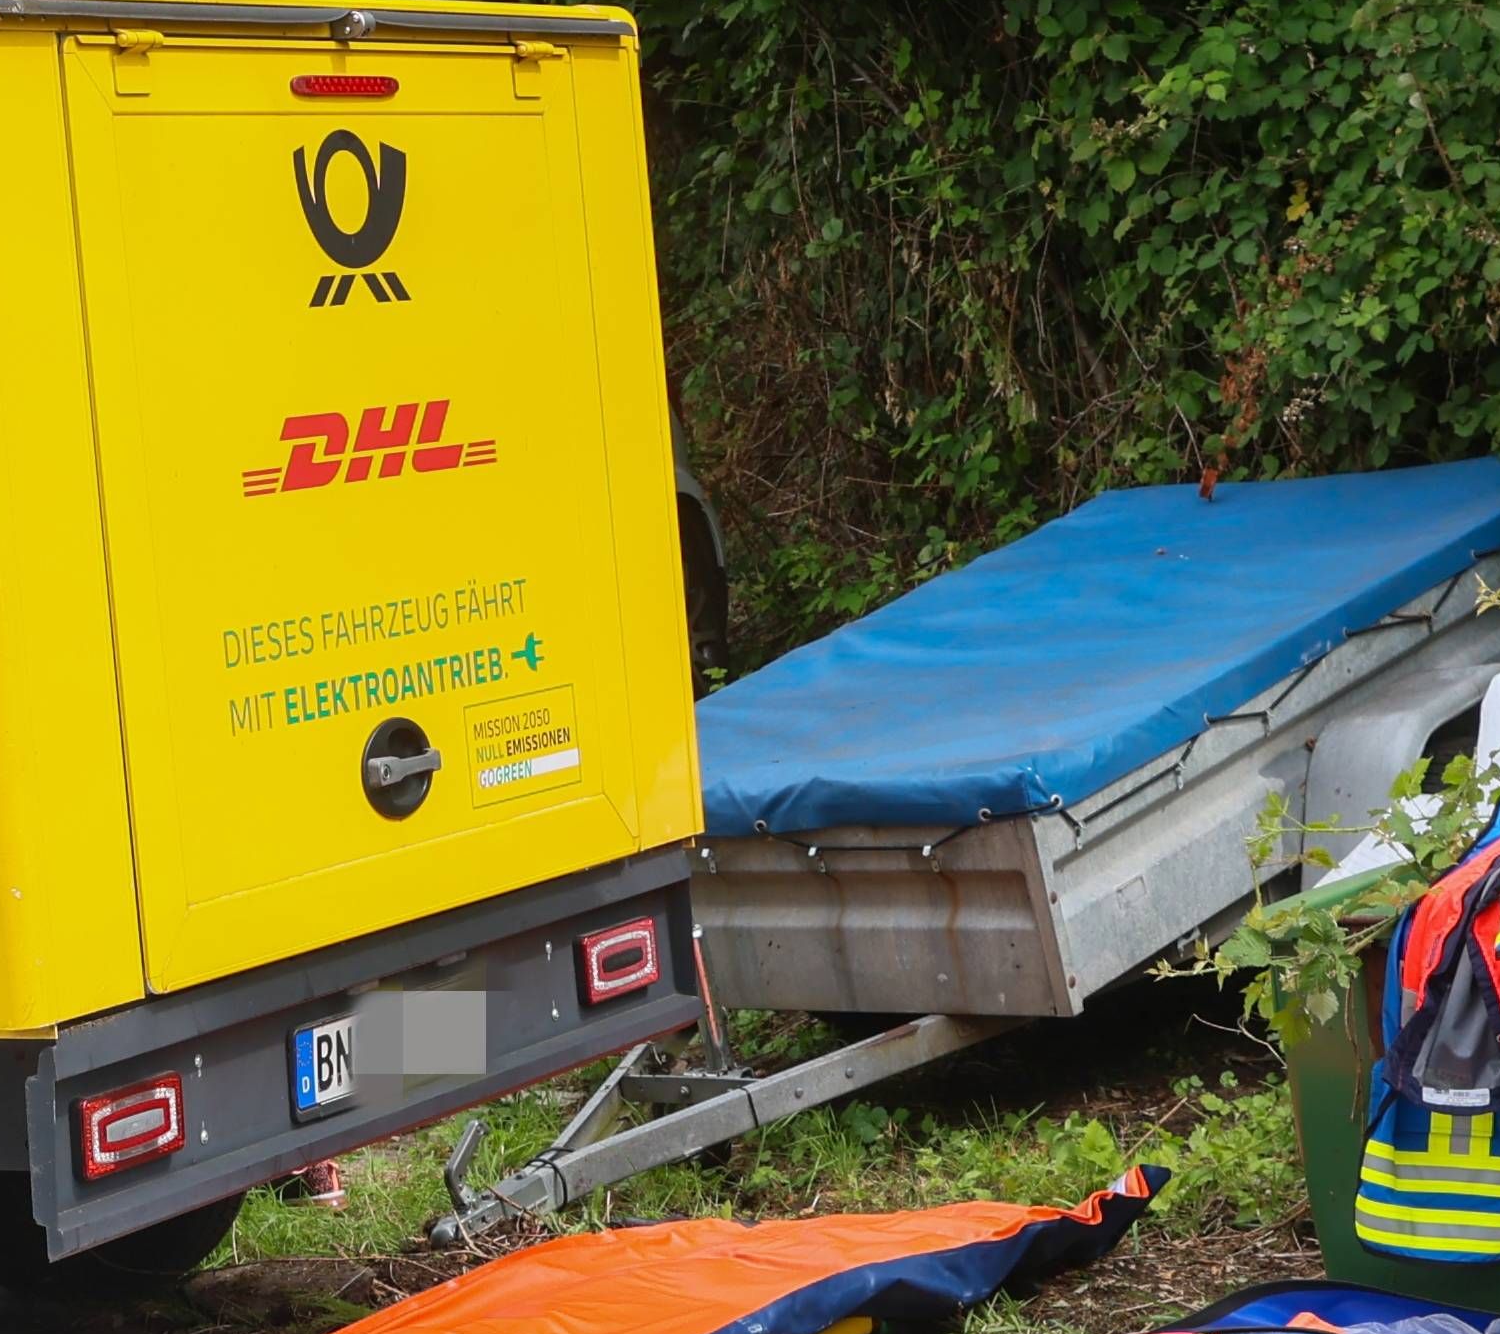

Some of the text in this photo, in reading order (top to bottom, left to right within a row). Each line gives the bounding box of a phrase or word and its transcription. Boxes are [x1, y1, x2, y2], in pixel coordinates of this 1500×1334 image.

[279, 399, 464, 493] DHL
[223, 579, 527, 669] DIESES FAHRZEUG FÄHRT
[229, 646, 509, 737] MIT ELEKTROANTRIEB.
[473, 707, 551, 741] MISSION 2050
[476, 726, 571, 764] NULL EMISSIONEN
[479, 759, 533, 788] GOGREEN
[301, 1075, 311, 1094] D
[316, 1025, 354, 1093] BN
